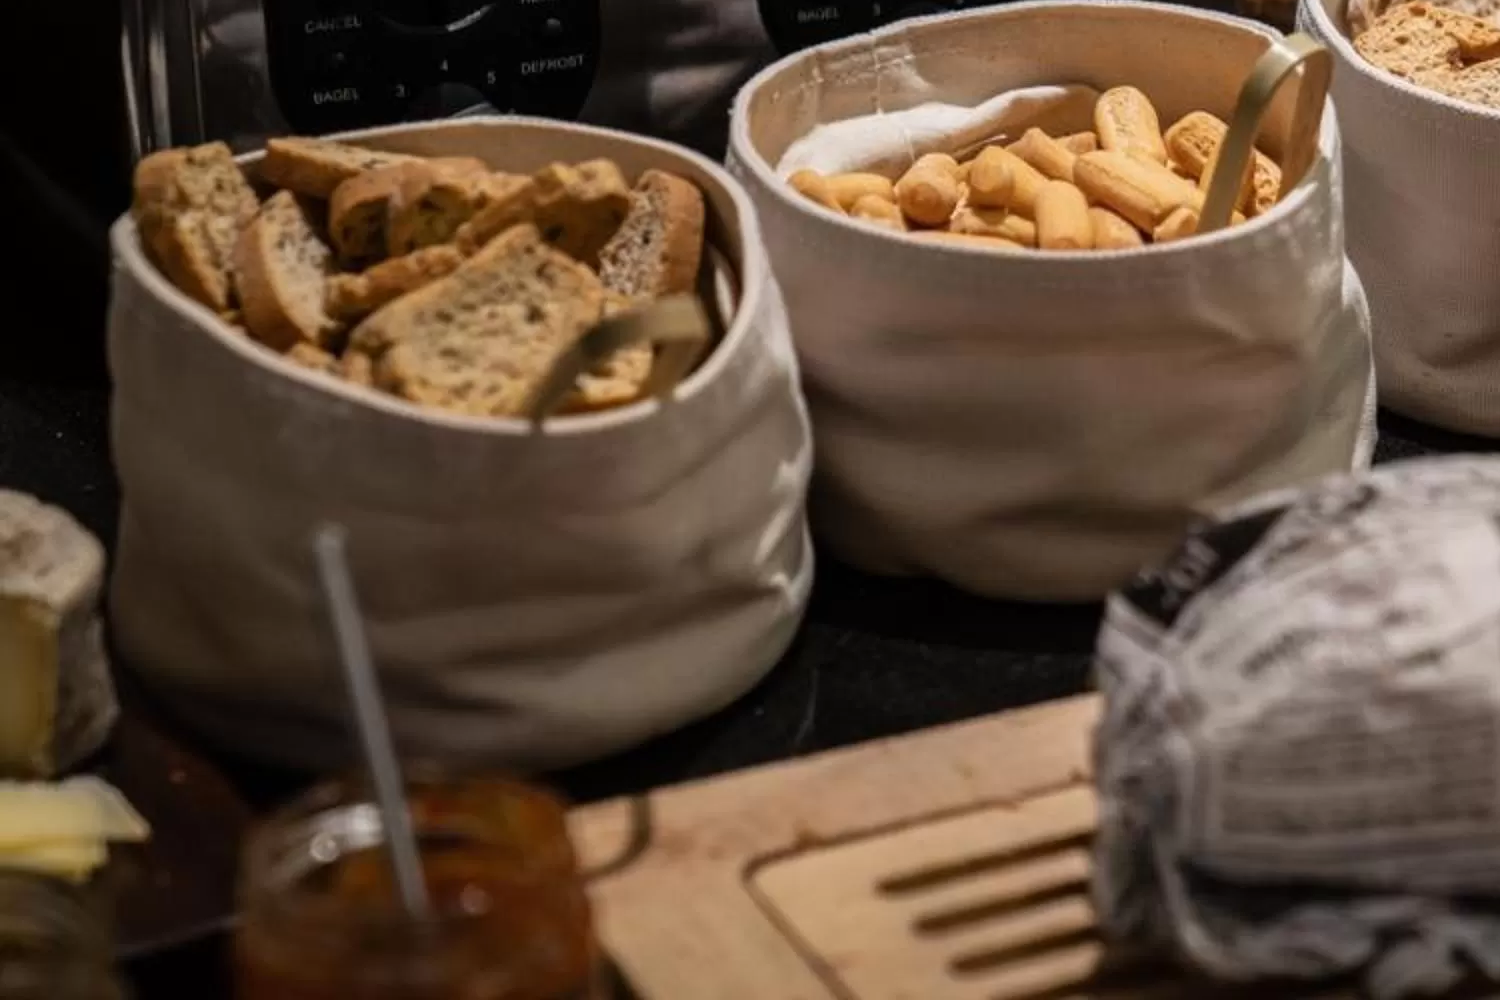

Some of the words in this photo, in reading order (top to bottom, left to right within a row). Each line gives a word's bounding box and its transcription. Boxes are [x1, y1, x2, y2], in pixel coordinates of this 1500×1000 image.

[797, 6, 840, 23] BAGEL
[304, 15, 362, 34] CANCEL
[521, 53, 585, 75] DEFROST
[312, 87, 361, 105] BAGEL
